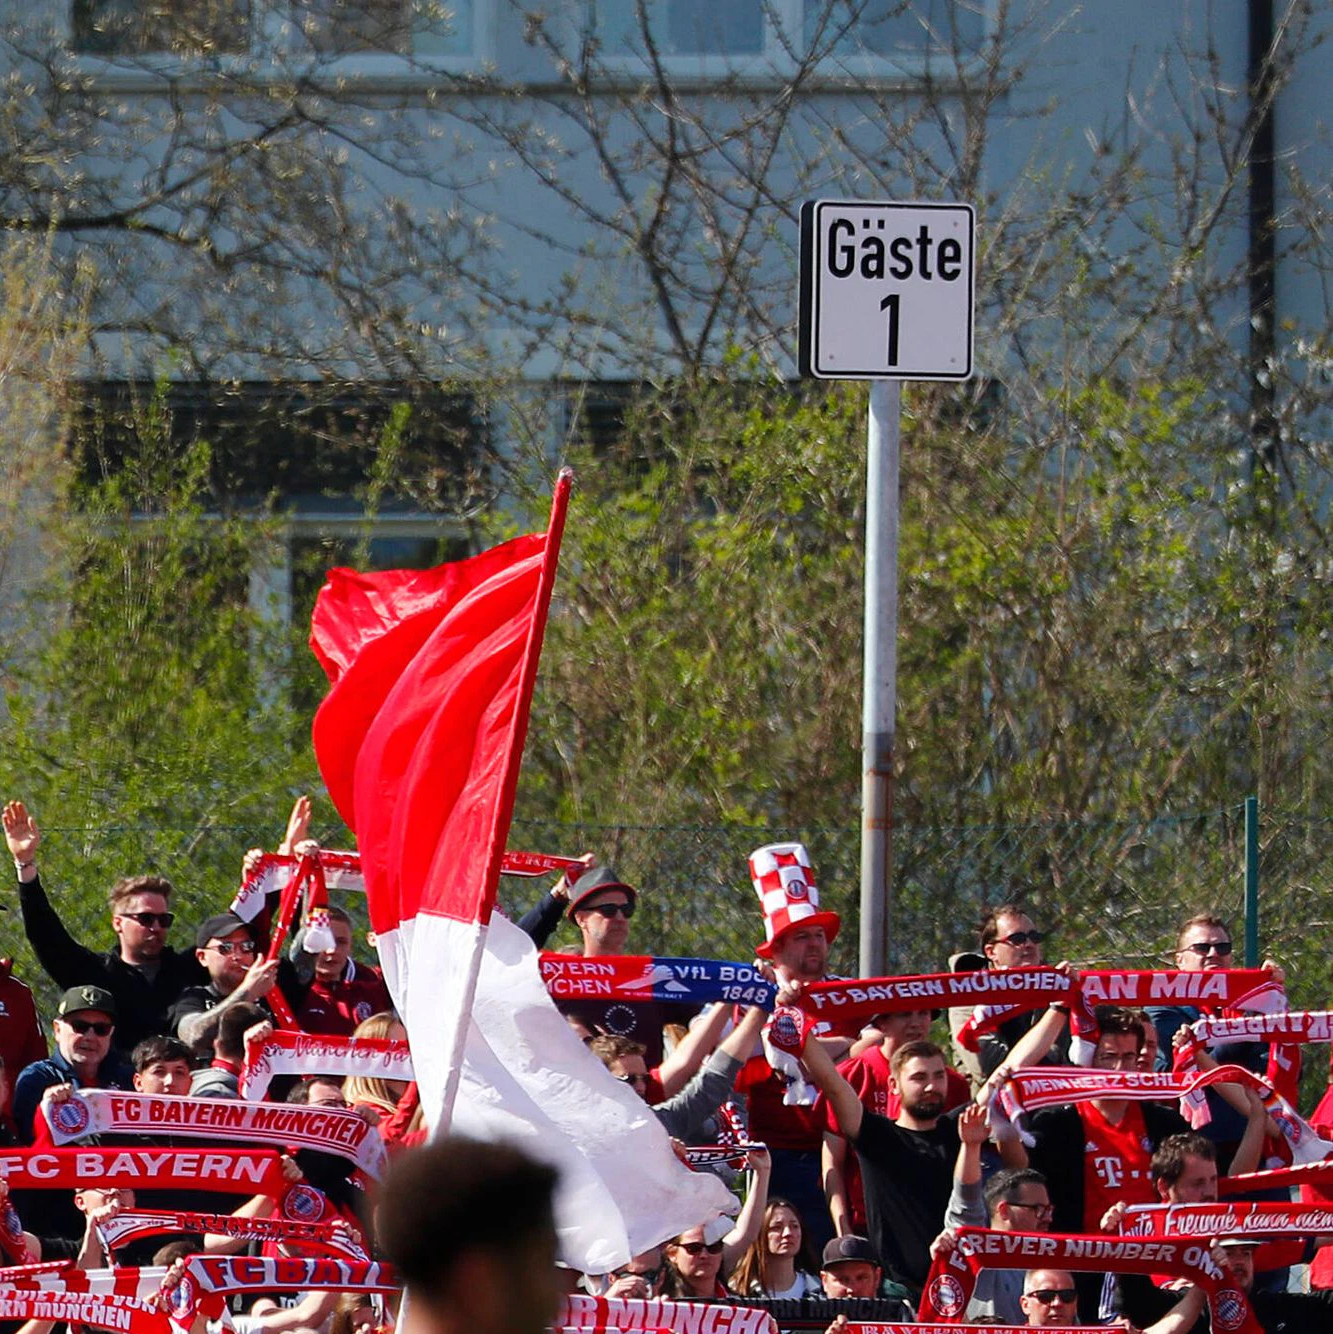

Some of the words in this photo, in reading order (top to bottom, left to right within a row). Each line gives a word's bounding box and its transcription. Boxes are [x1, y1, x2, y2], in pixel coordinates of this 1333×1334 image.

[828, 218, 962, 281] Gäste
[880, 294, 900, 366] 1
[721, 985, 769, 1004] 1848
[811, 989, 849, 1009] FC
[852, 979, 945, 1004] BAYERN
[950, 966, 1071, 995] MÜNCHEN
[1150, 974, 1229, 1000] MIA
[1023, 1077, 1072, 1097] MEIN
[1074, 1075, 1123, 1095] HERZ
[111, 1098, 143, 1122] FC
[148, 1099, 247, 1129] BAYERN
[250, 1103, 369, 1148] MÜNCHEN
[76, 1153, 273, 1182] BAYERN
[1165, 1204, 1237, 1236] Freunde
[1242, 1203, 1290, 1230] kann
[949, 1234, 1060, 1272] FOREVER
[1065, 1238, 1176, 1263] NUMBER
